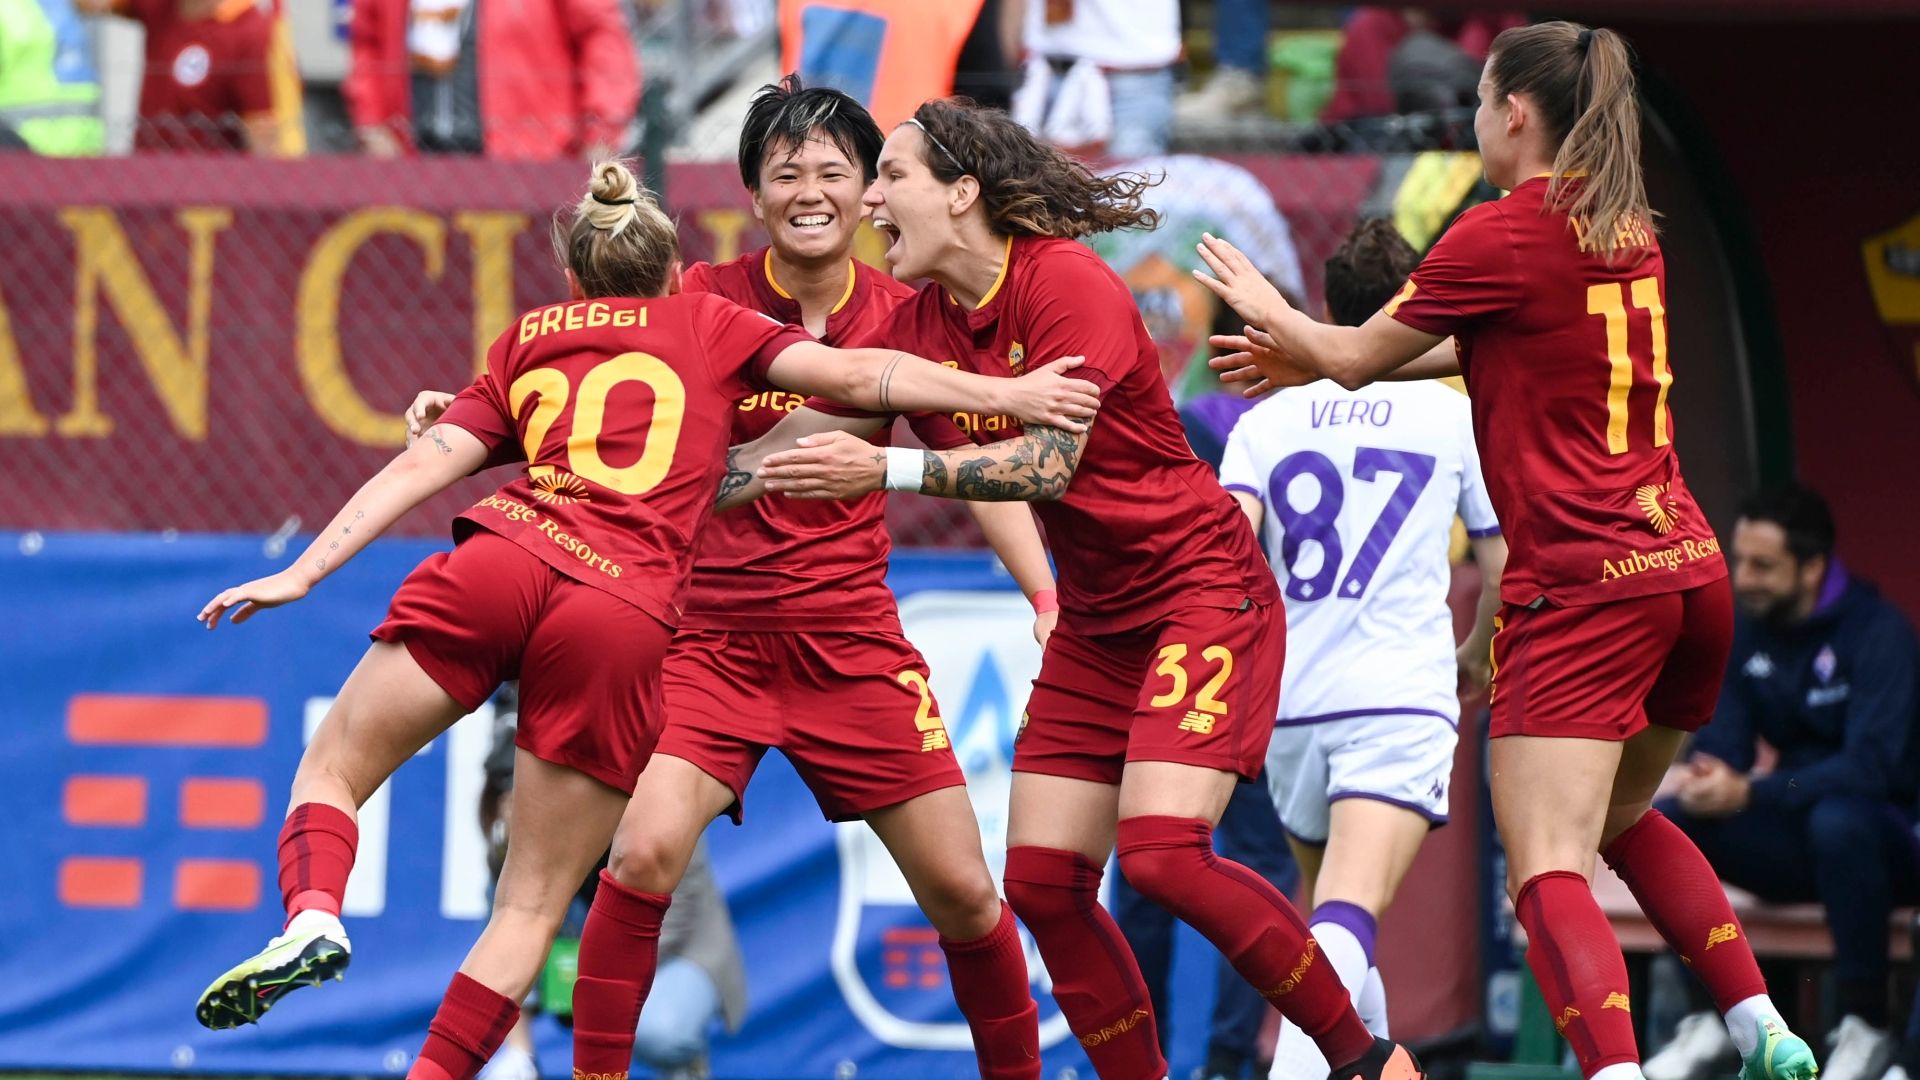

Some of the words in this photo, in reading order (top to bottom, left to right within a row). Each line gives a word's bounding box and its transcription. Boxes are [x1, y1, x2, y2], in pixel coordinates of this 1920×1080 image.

[519, 302, 648, 345] GREGGI
[1587, 277, 1673, 454] 11
[508, 351, 686, 496] 20
[1311, 399, 1392, 429] VERO
[537, 518, 624, 578] Resorts
[1268, 446, 1437, 602] 87
[1601, 549, 1684, 583] Auberge
[897, 669, 945, 732] 2
[1150, 643, 1233, 715] 32
[1080, 1009, 1149, 1047] OMA
